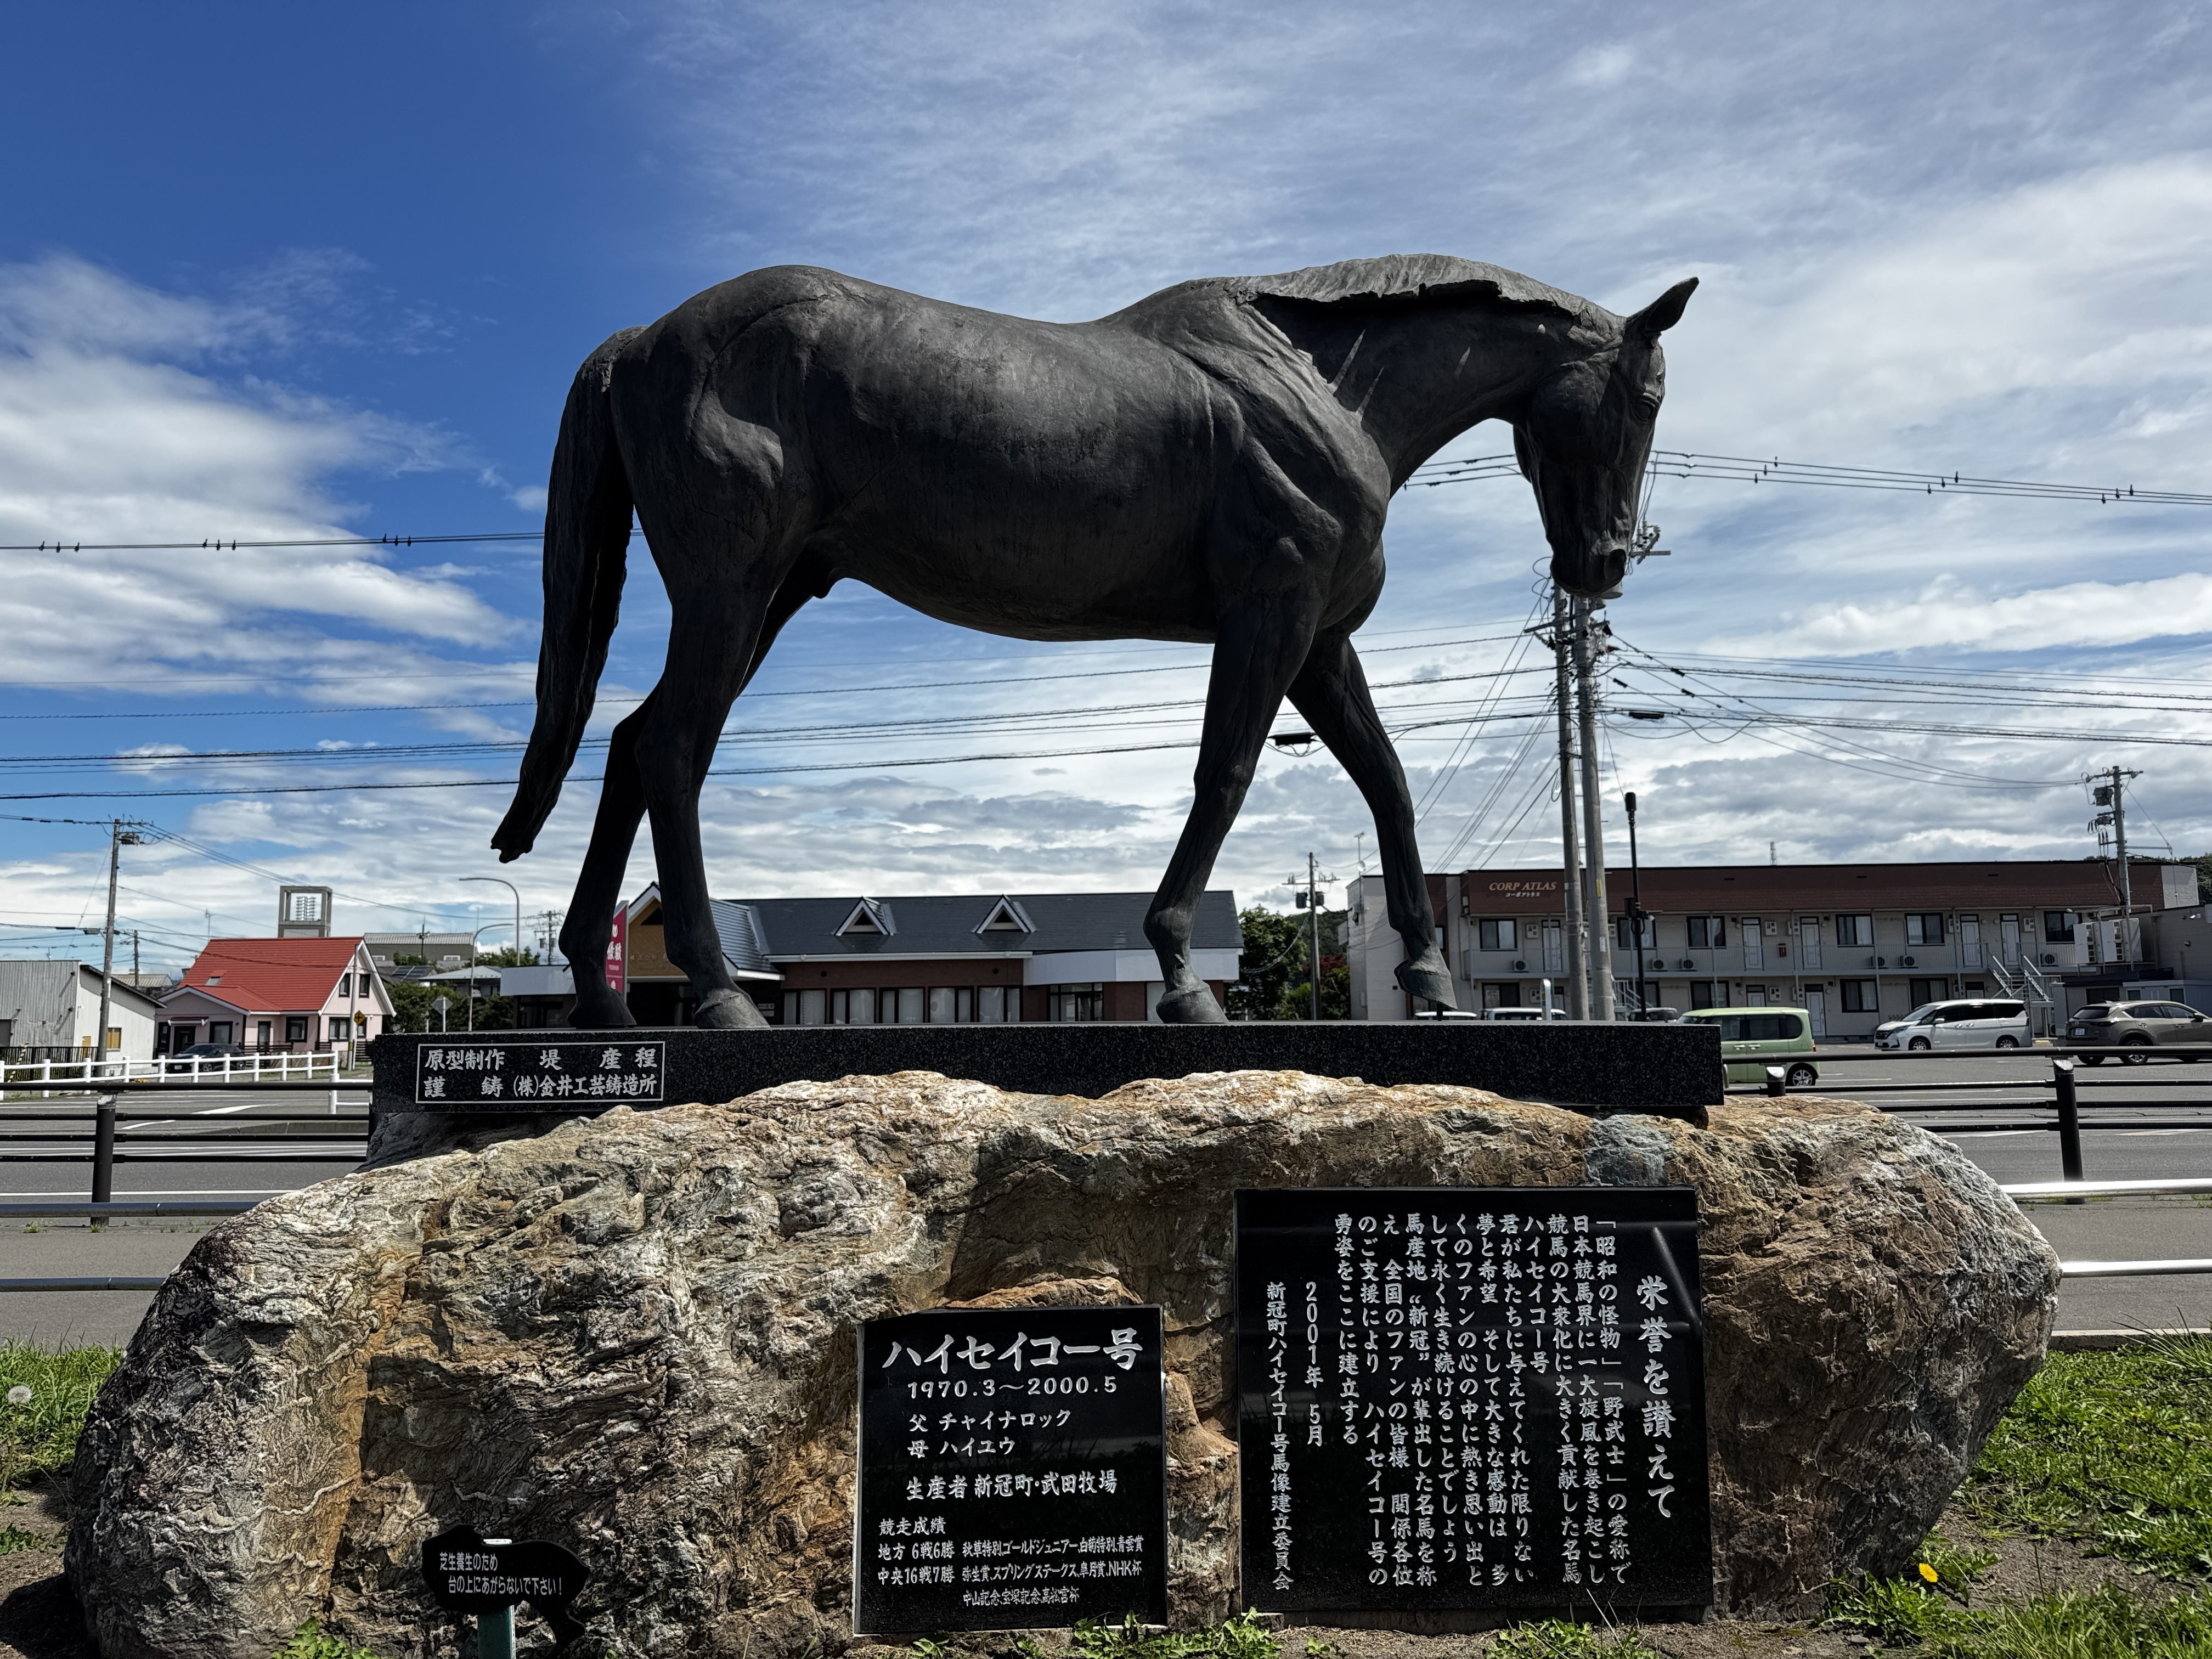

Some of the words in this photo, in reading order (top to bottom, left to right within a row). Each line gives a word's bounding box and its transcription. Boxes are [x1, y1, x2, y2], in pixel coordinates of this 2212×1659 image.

[1488, 882, 1520, 891] CORP
[1522, 882, 1557, 891] ATLAS
[424, 1048, 505, 1071] 原型制作
[1334, 1213, 1360, 1444] 勇姿をここに建立する
[1523, 1216, 1550, 1374] ハイセイコー号
[882, 1327, 1143, 1374] ハイセイコー号
[1431, 1215, 1459, 1562] して永く生き続けることでしょう
[1454, 1214, 1484, 1586] くのファンの心の中に熱き思い出と
[1499, 1214, 1534, 1582] 君が私たちに与えてくれた限りない
[1546, 1214, 1581, 1584] 競馬の大衆化に大きく貢献した名馬
[1572, 1215, 1605, 1583] 日本競馬界に一大旋風を巻き起こし
[1637, 1275, 1677, 1518] 栄誉を讃えて
[907, 1440, 929, 1459] 母
[939, 1436, 1015, 1457] ハイユウ
[909, 1414, 928, 1432] 父
[939, 1409, 1071, 1431] チャイナロック
[1266, 1282, 1294, 1590] 新冠町ハイセイコー号馬像建立委員会
[878, 1516, 946, 1536] 競走成績
[906, 1474, 968, 1501] 生産者
[439, 1551, 498, 1571] 芝生養生のため
[878, 1542, 906, 1561] 地方
[912, 1540, 955, 1560] 6戦6勝
